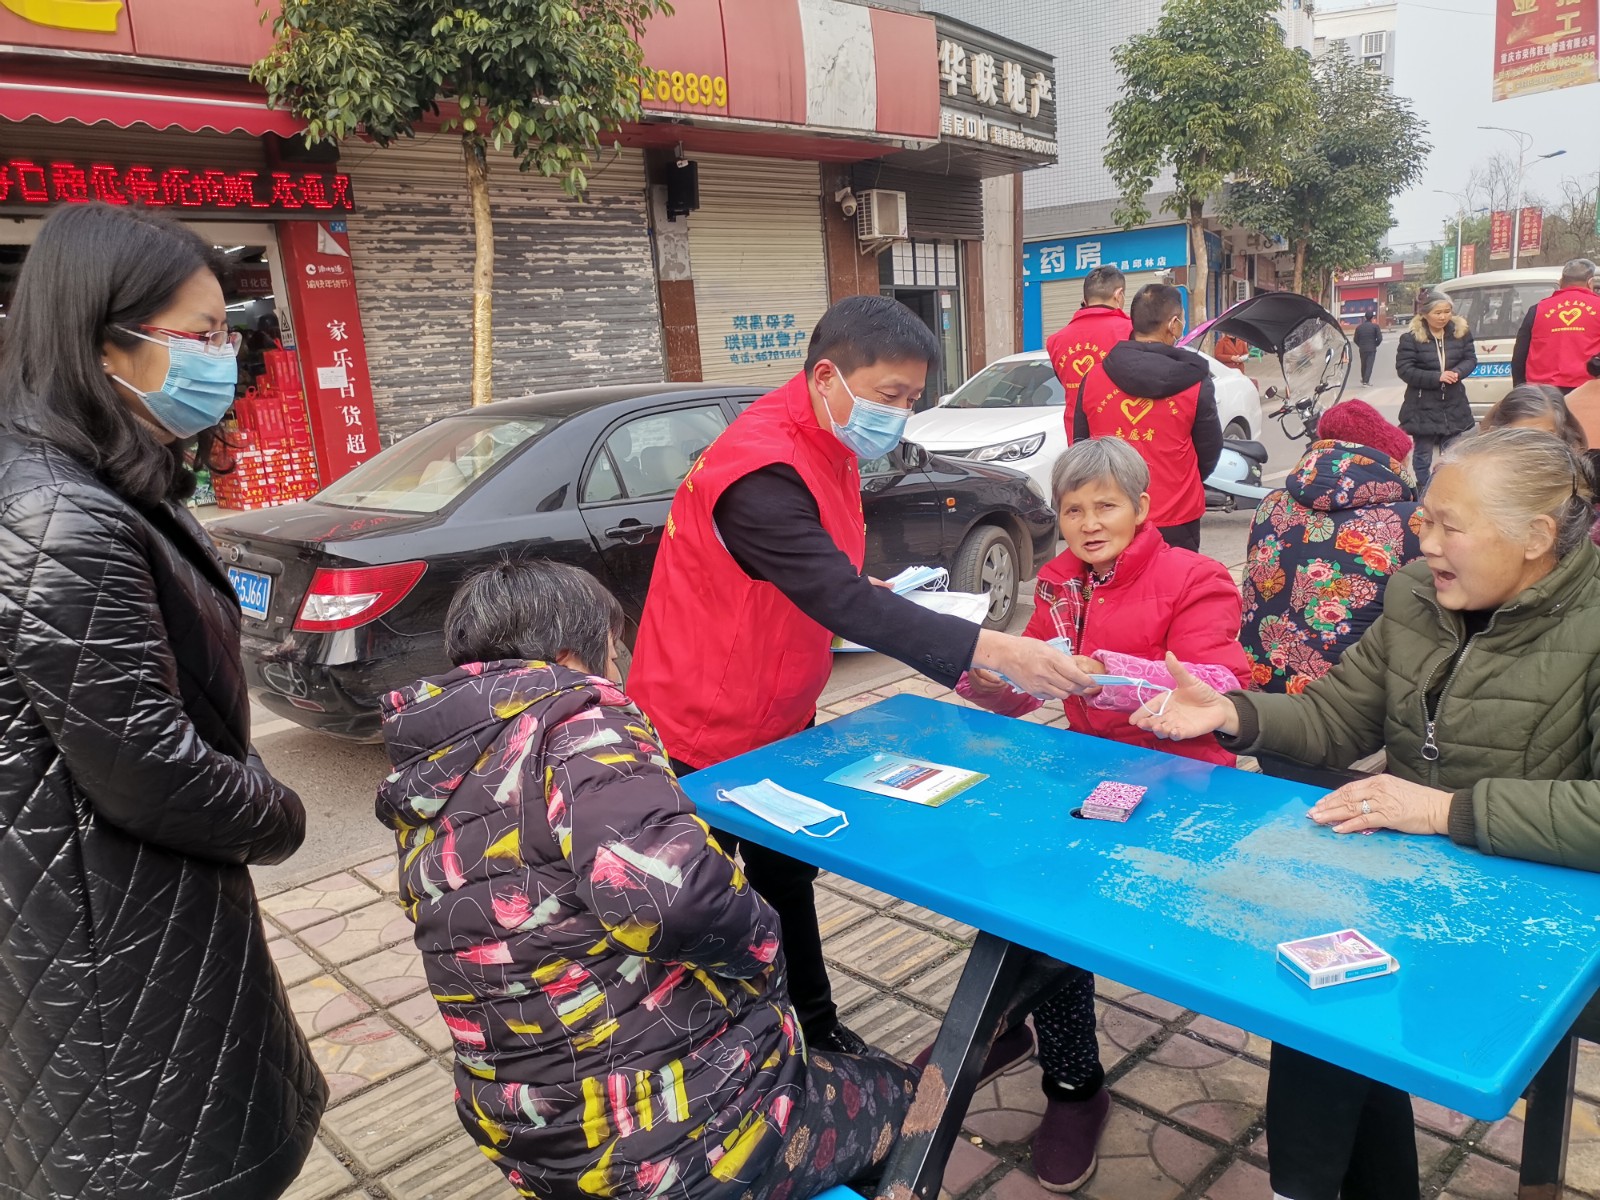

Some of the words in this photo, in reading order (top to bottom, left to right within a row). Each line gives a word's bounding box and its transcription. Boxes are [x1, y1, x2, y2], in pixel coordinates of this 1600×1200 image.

[938, 39, 1053, 119] 华联地产
[326, 319, 367, 467] 家乐百货超
[1115, 426, 1155, 442] 志愿者
